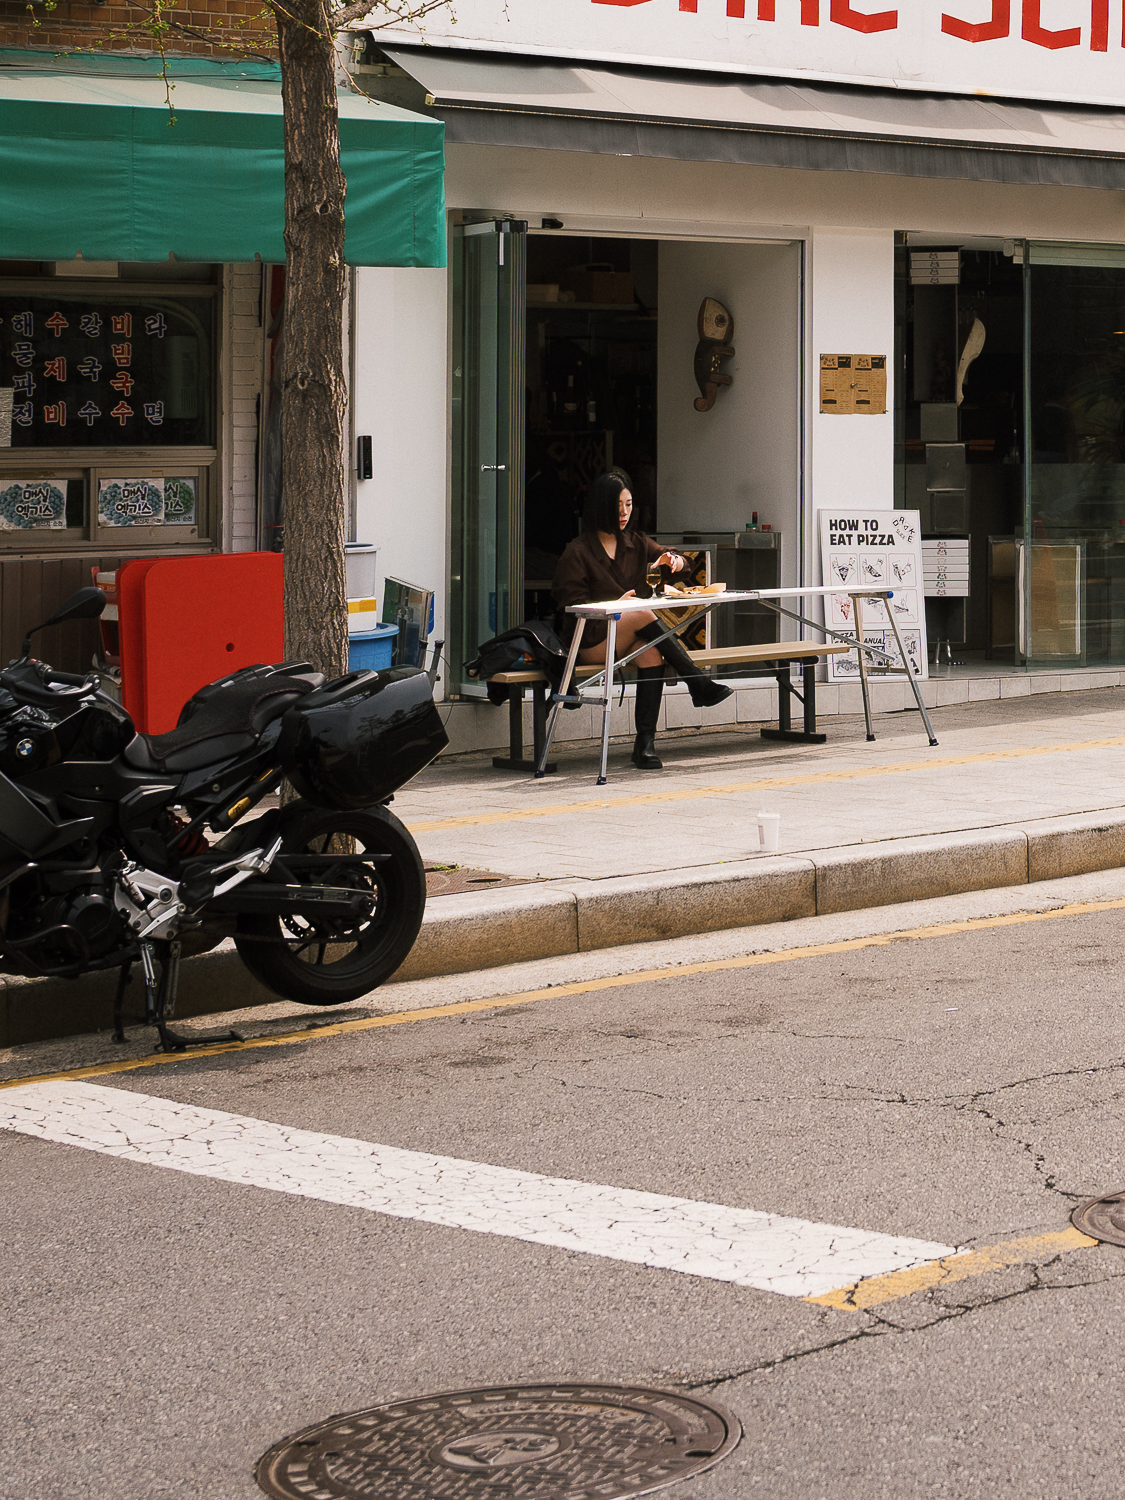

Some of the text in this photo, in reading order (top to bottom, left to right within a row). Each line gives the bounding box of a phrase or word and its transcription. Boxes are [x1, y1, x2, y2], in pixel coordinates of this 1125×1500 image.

[11, 312, 36, 426] 해물파전
[44, 312, 69, 426] 수제비
[77, 312, 103, 426] 칼국수
[110, 312, 135, 426] 비빔국수
[143, 312, 167, 426] 라면
[23, 487, 50, 502] 매실
[122, 485, 148, 502] 매실
[164, 483, 180, 500] 실
[15, 503, 54, 518] 엑기스
[115, 502, 152, 518] 엑기스
[164, 499, 184, 513] 기스
[829, 519, 879, 531] HOW TO
[830, 534, 896, 546] EAT PIZZA
[862, 637, 886, 645] ANUAL
